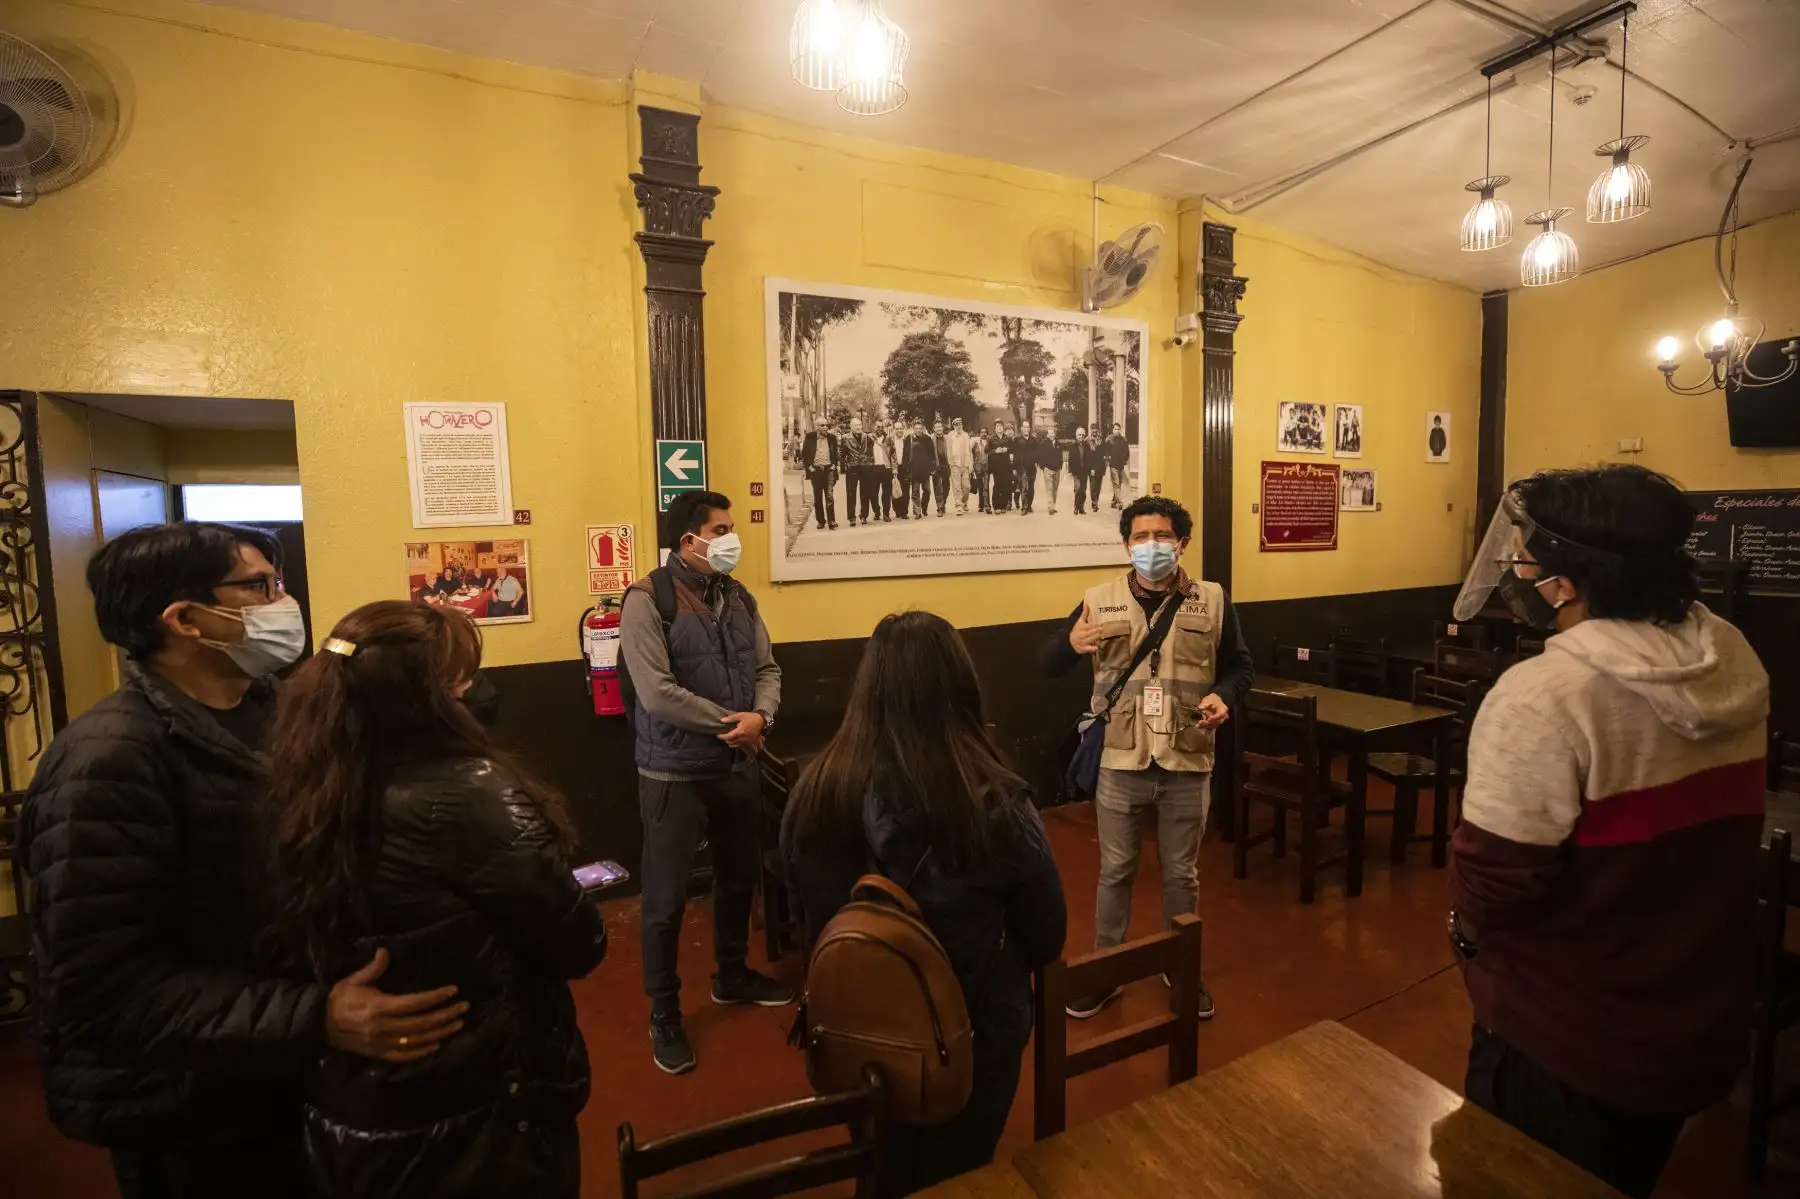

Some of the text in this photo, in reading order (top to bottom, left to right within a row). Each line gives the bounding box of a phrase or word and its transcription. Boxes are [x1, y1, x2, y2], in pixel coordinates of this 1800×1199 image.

[751, 484, 763, 494] 40
[1714, 496, 1784, 511] Especiales
[515, 512, 529, 523] 42
[752, 511, 763, 521] 41
[621, 527, 628, 537] 3
[1098, 605, 1128, 614] TURISMO
[1178, 605, 1208, 615] LIMA
[600, 682, 608, 694] 3
